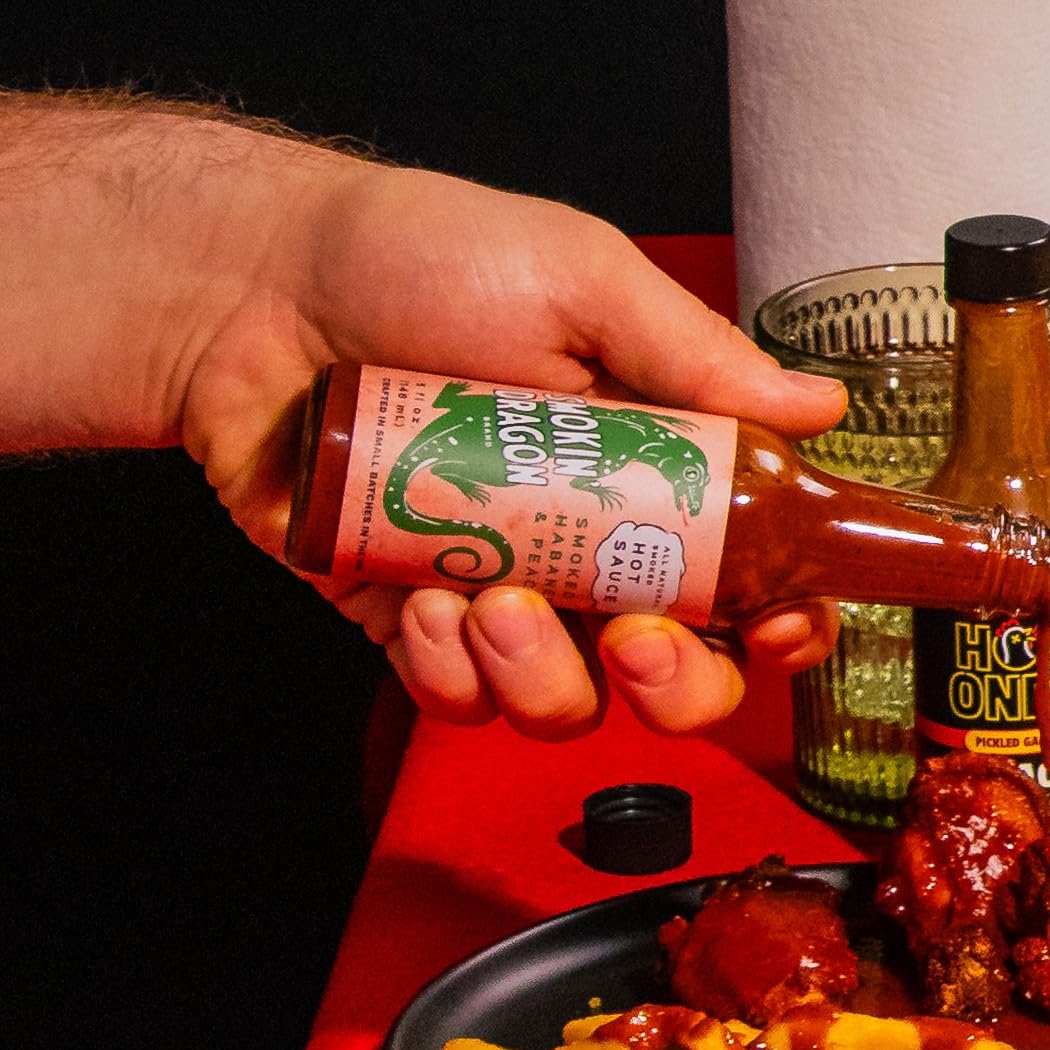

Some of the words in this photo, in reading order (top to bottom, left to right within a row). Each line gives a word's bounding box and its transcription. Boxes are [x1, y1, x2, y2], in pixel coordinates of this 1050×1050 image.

[379, 377, 391, 414] CRAFTED
[377, 415, 387, 427] IN
[483, 416, 493, 448] BRAND
[493, 388, 549, 486] DRAGON
[543, 392, 603, 479] SMOKIN
[371, 429, 385, 467] SMALL
[362, 472, 378, 524] BATCHES
[534, 511, 548, 523] &
[360, 525, 370, 538] IN
[524, 537, 545, 588] PEAC
[563, 517, 589, 600] SMOKED
[602, 539, 627, 604] SAUCE
[627, 542, 647, 585] HOT
[646, 545, 659, 586] SMOKED
[662, 545, 671, 565] ALL
[975, 736, 1020, 749] PICKLED
